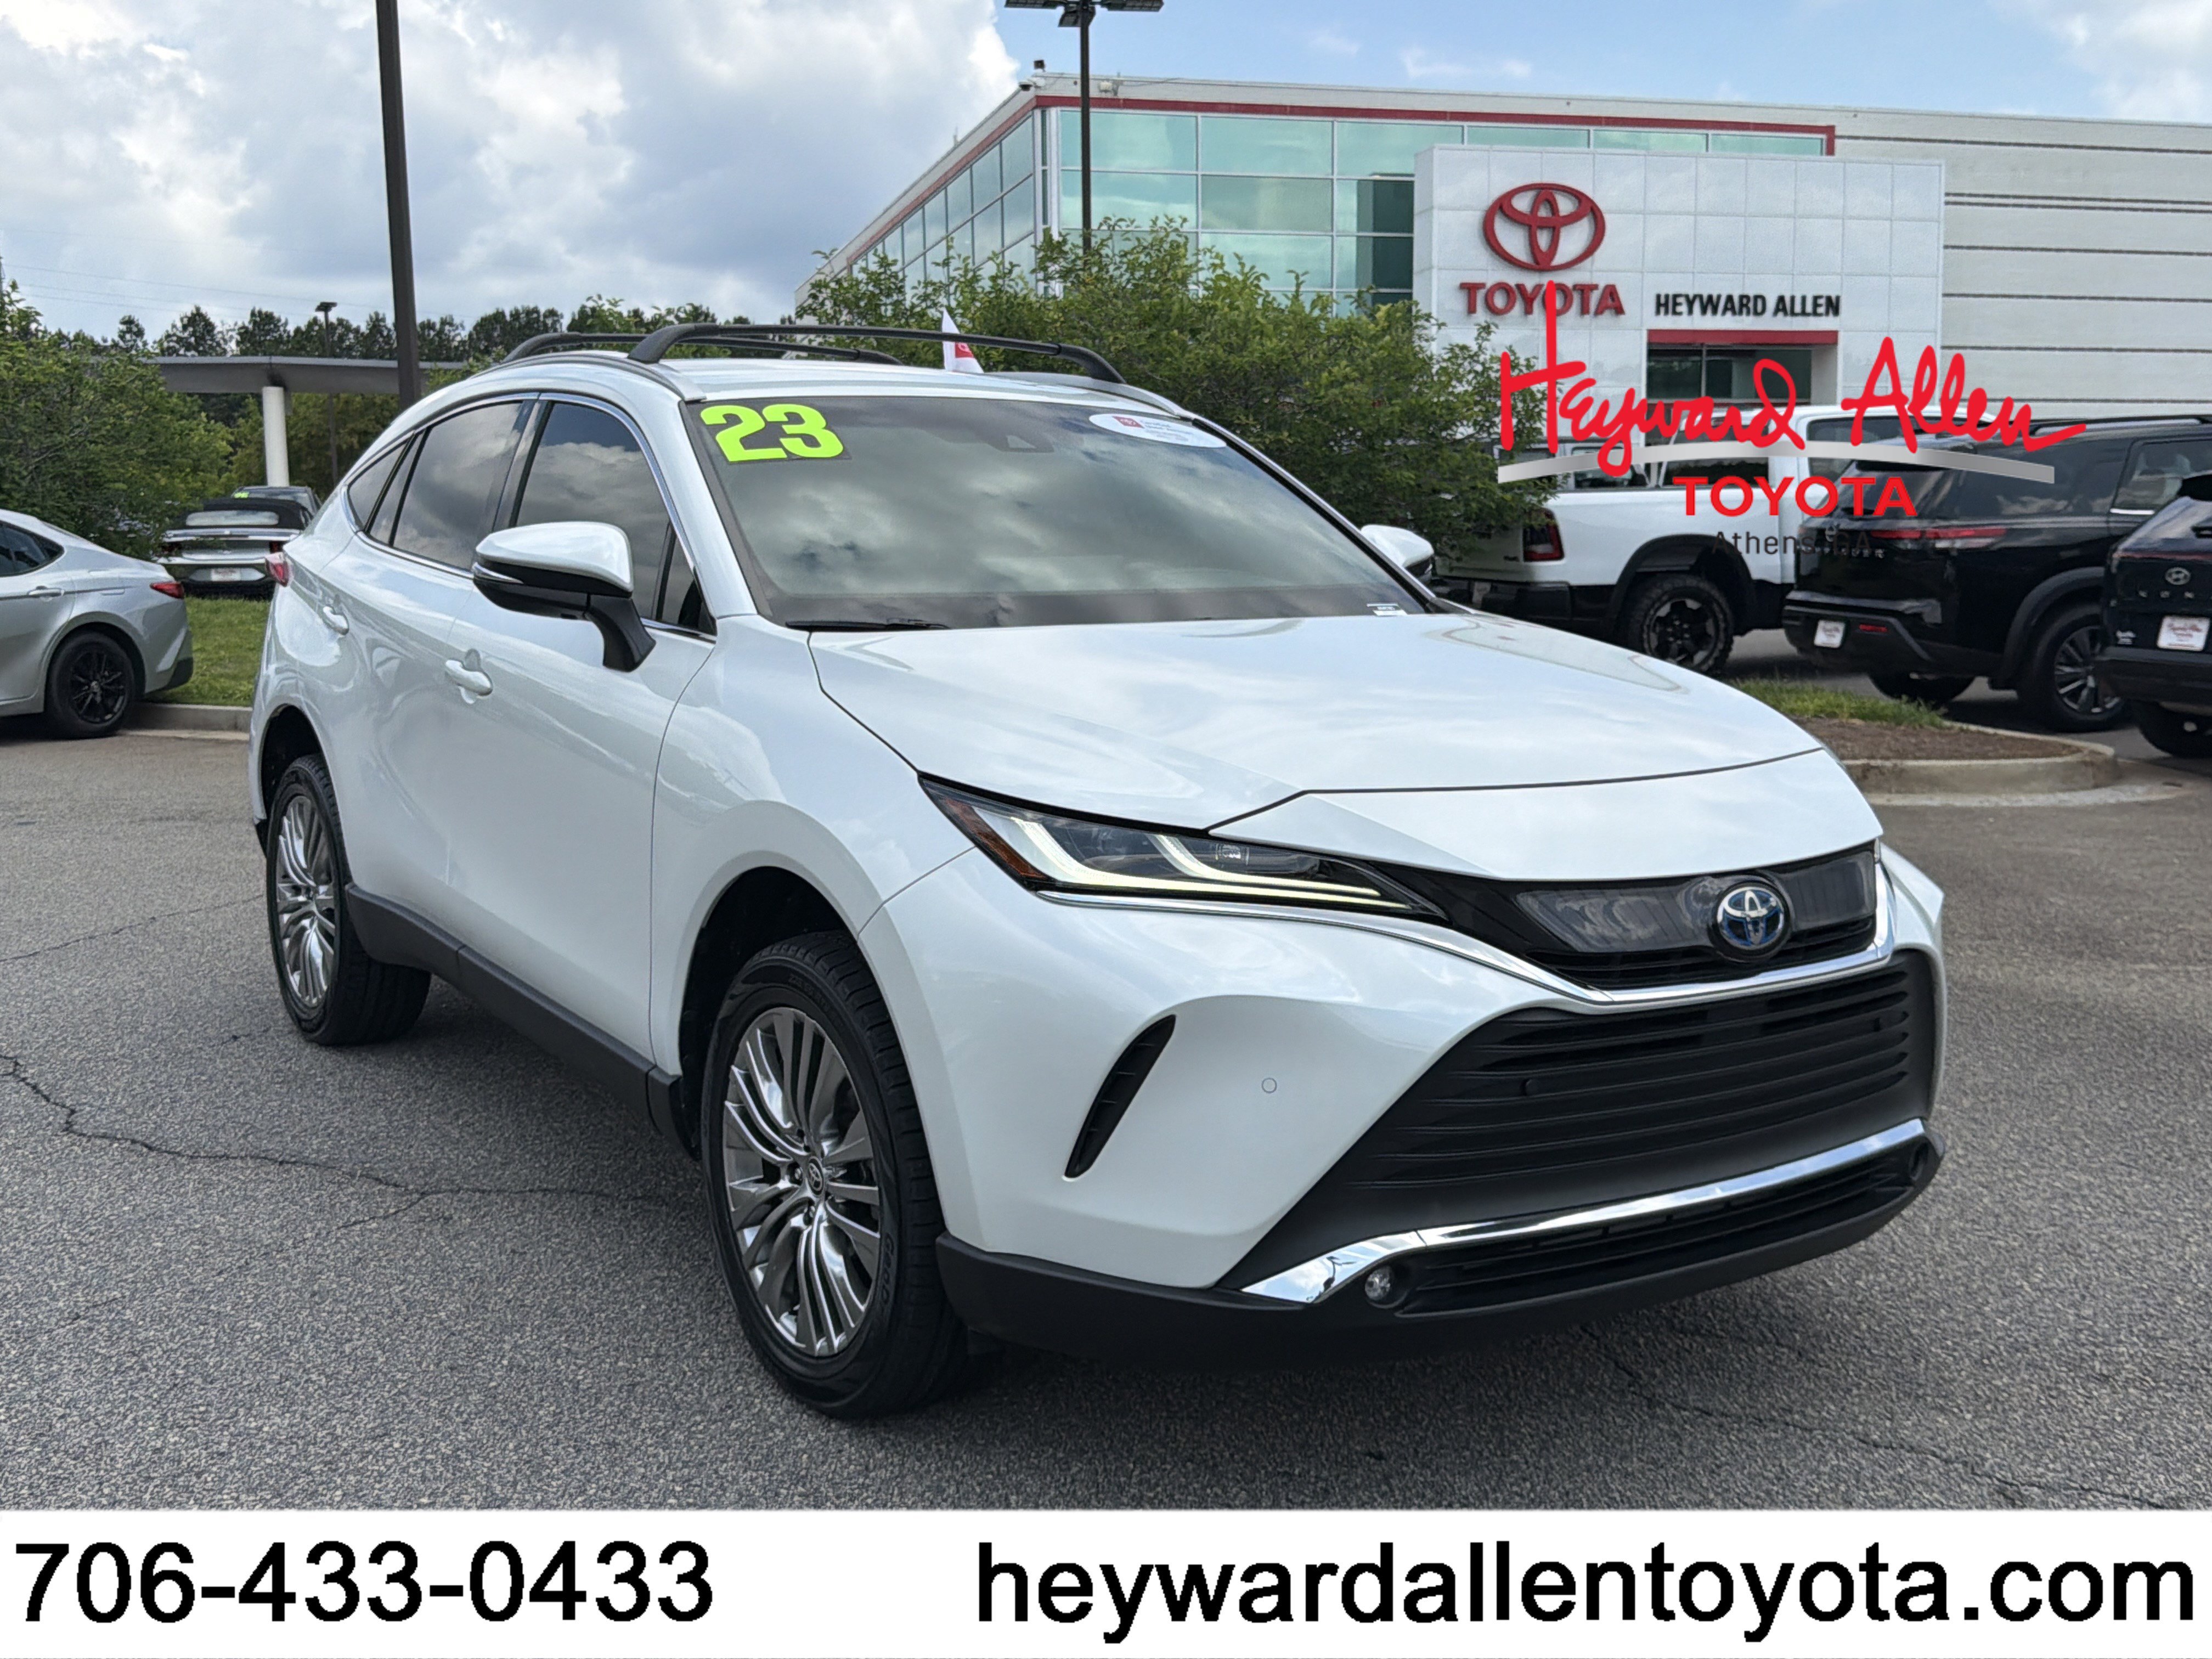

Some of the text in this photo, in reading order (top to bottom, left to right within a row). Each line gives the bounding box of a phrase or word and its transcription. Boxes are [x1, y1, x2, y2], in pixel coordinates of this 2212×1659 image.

[1459, 281, 1626, 316] TOYOTA
[1655, 293, 1841, 318] HEYWARD ALLEN
[700, 404, 844, 462] 23
